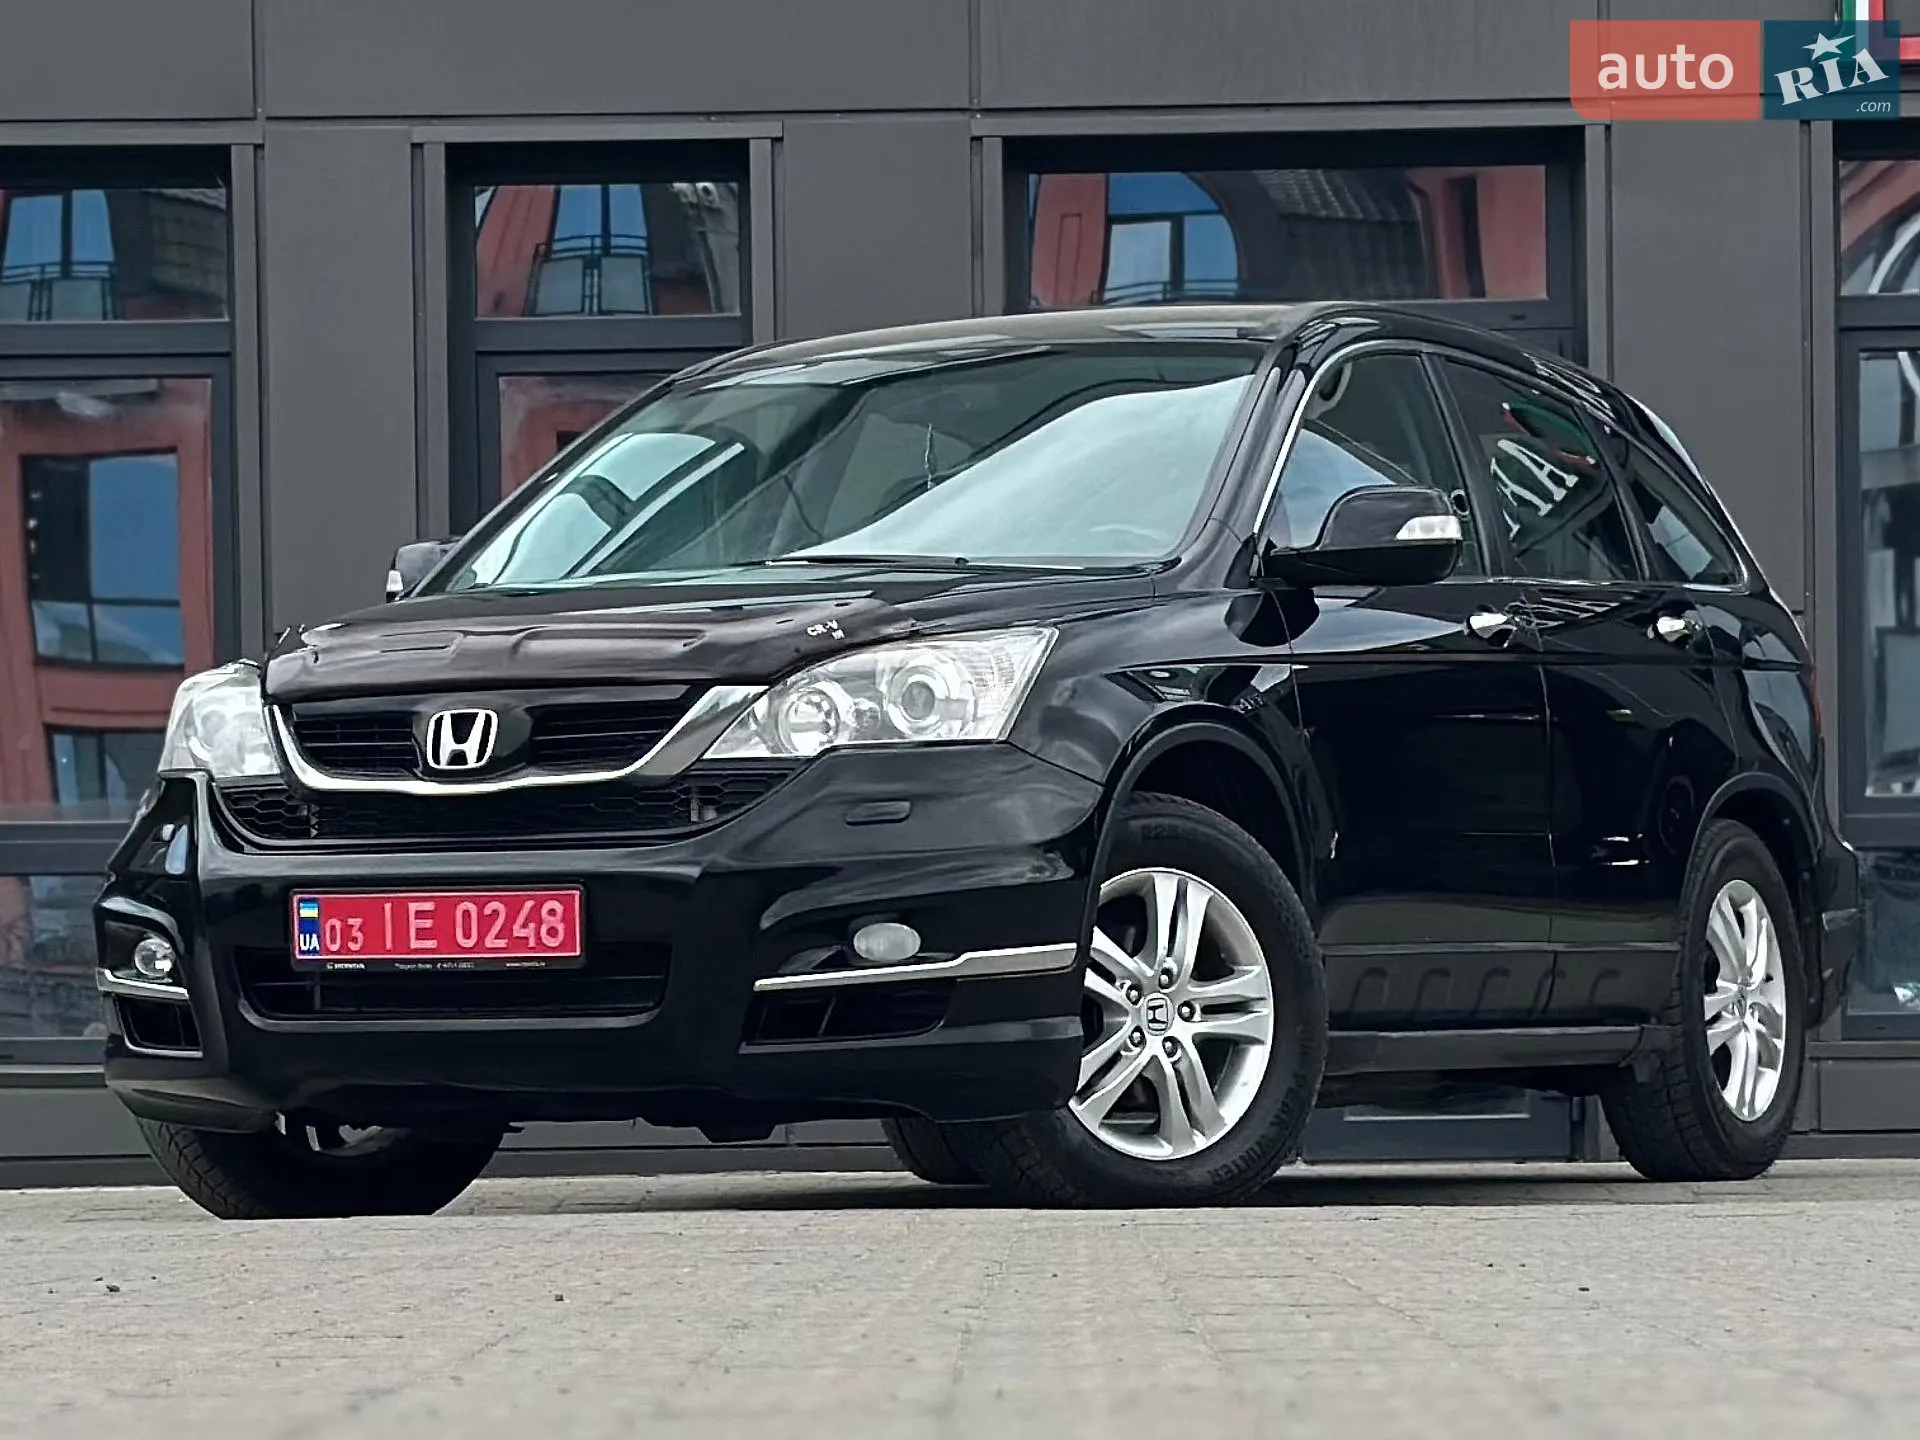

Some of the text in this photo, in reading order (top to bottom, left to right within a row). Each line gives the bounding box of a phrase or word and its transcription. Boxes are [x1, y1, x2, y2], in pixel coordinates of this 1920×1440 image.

[299, 933, 320, 951] UA
[325, 917, 364, 952] 03
[455, 899, 564, 949] 0248
